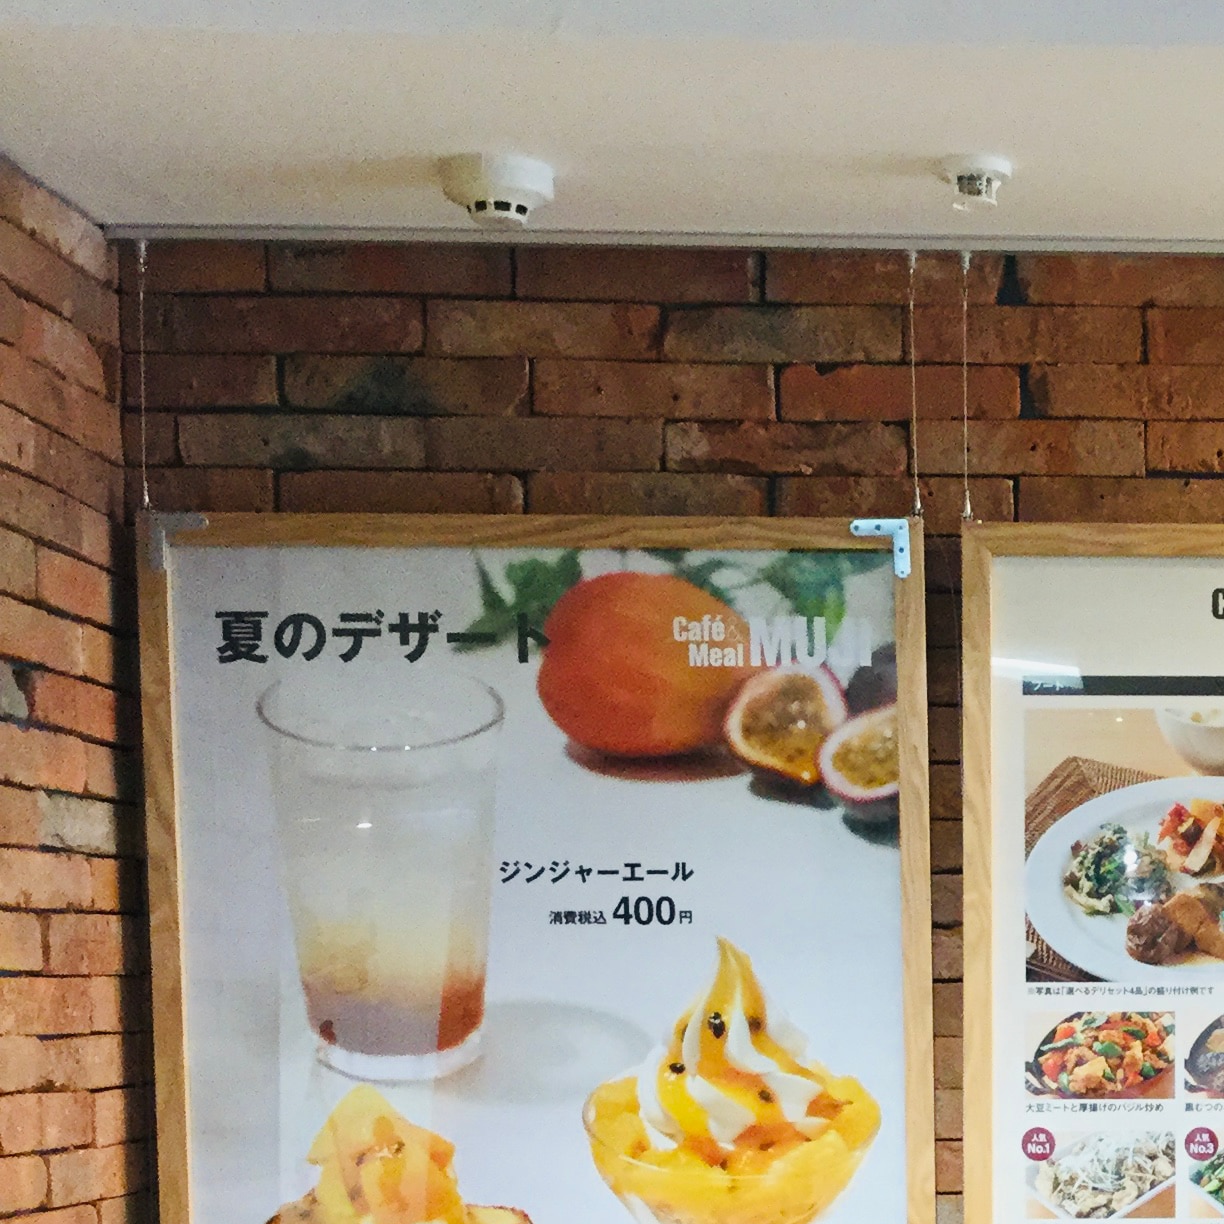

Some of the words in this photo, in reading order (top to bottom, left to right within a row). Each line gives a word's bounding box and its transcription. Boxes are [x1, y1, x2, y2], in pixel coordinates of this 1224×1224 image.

[215, 609, 551, 664] 夏のデザート
[689, 643, 744, 667] Meal
[750, 616, 873, 667] MUJI
[499, 860, 694, 884] ジンジャーエール
